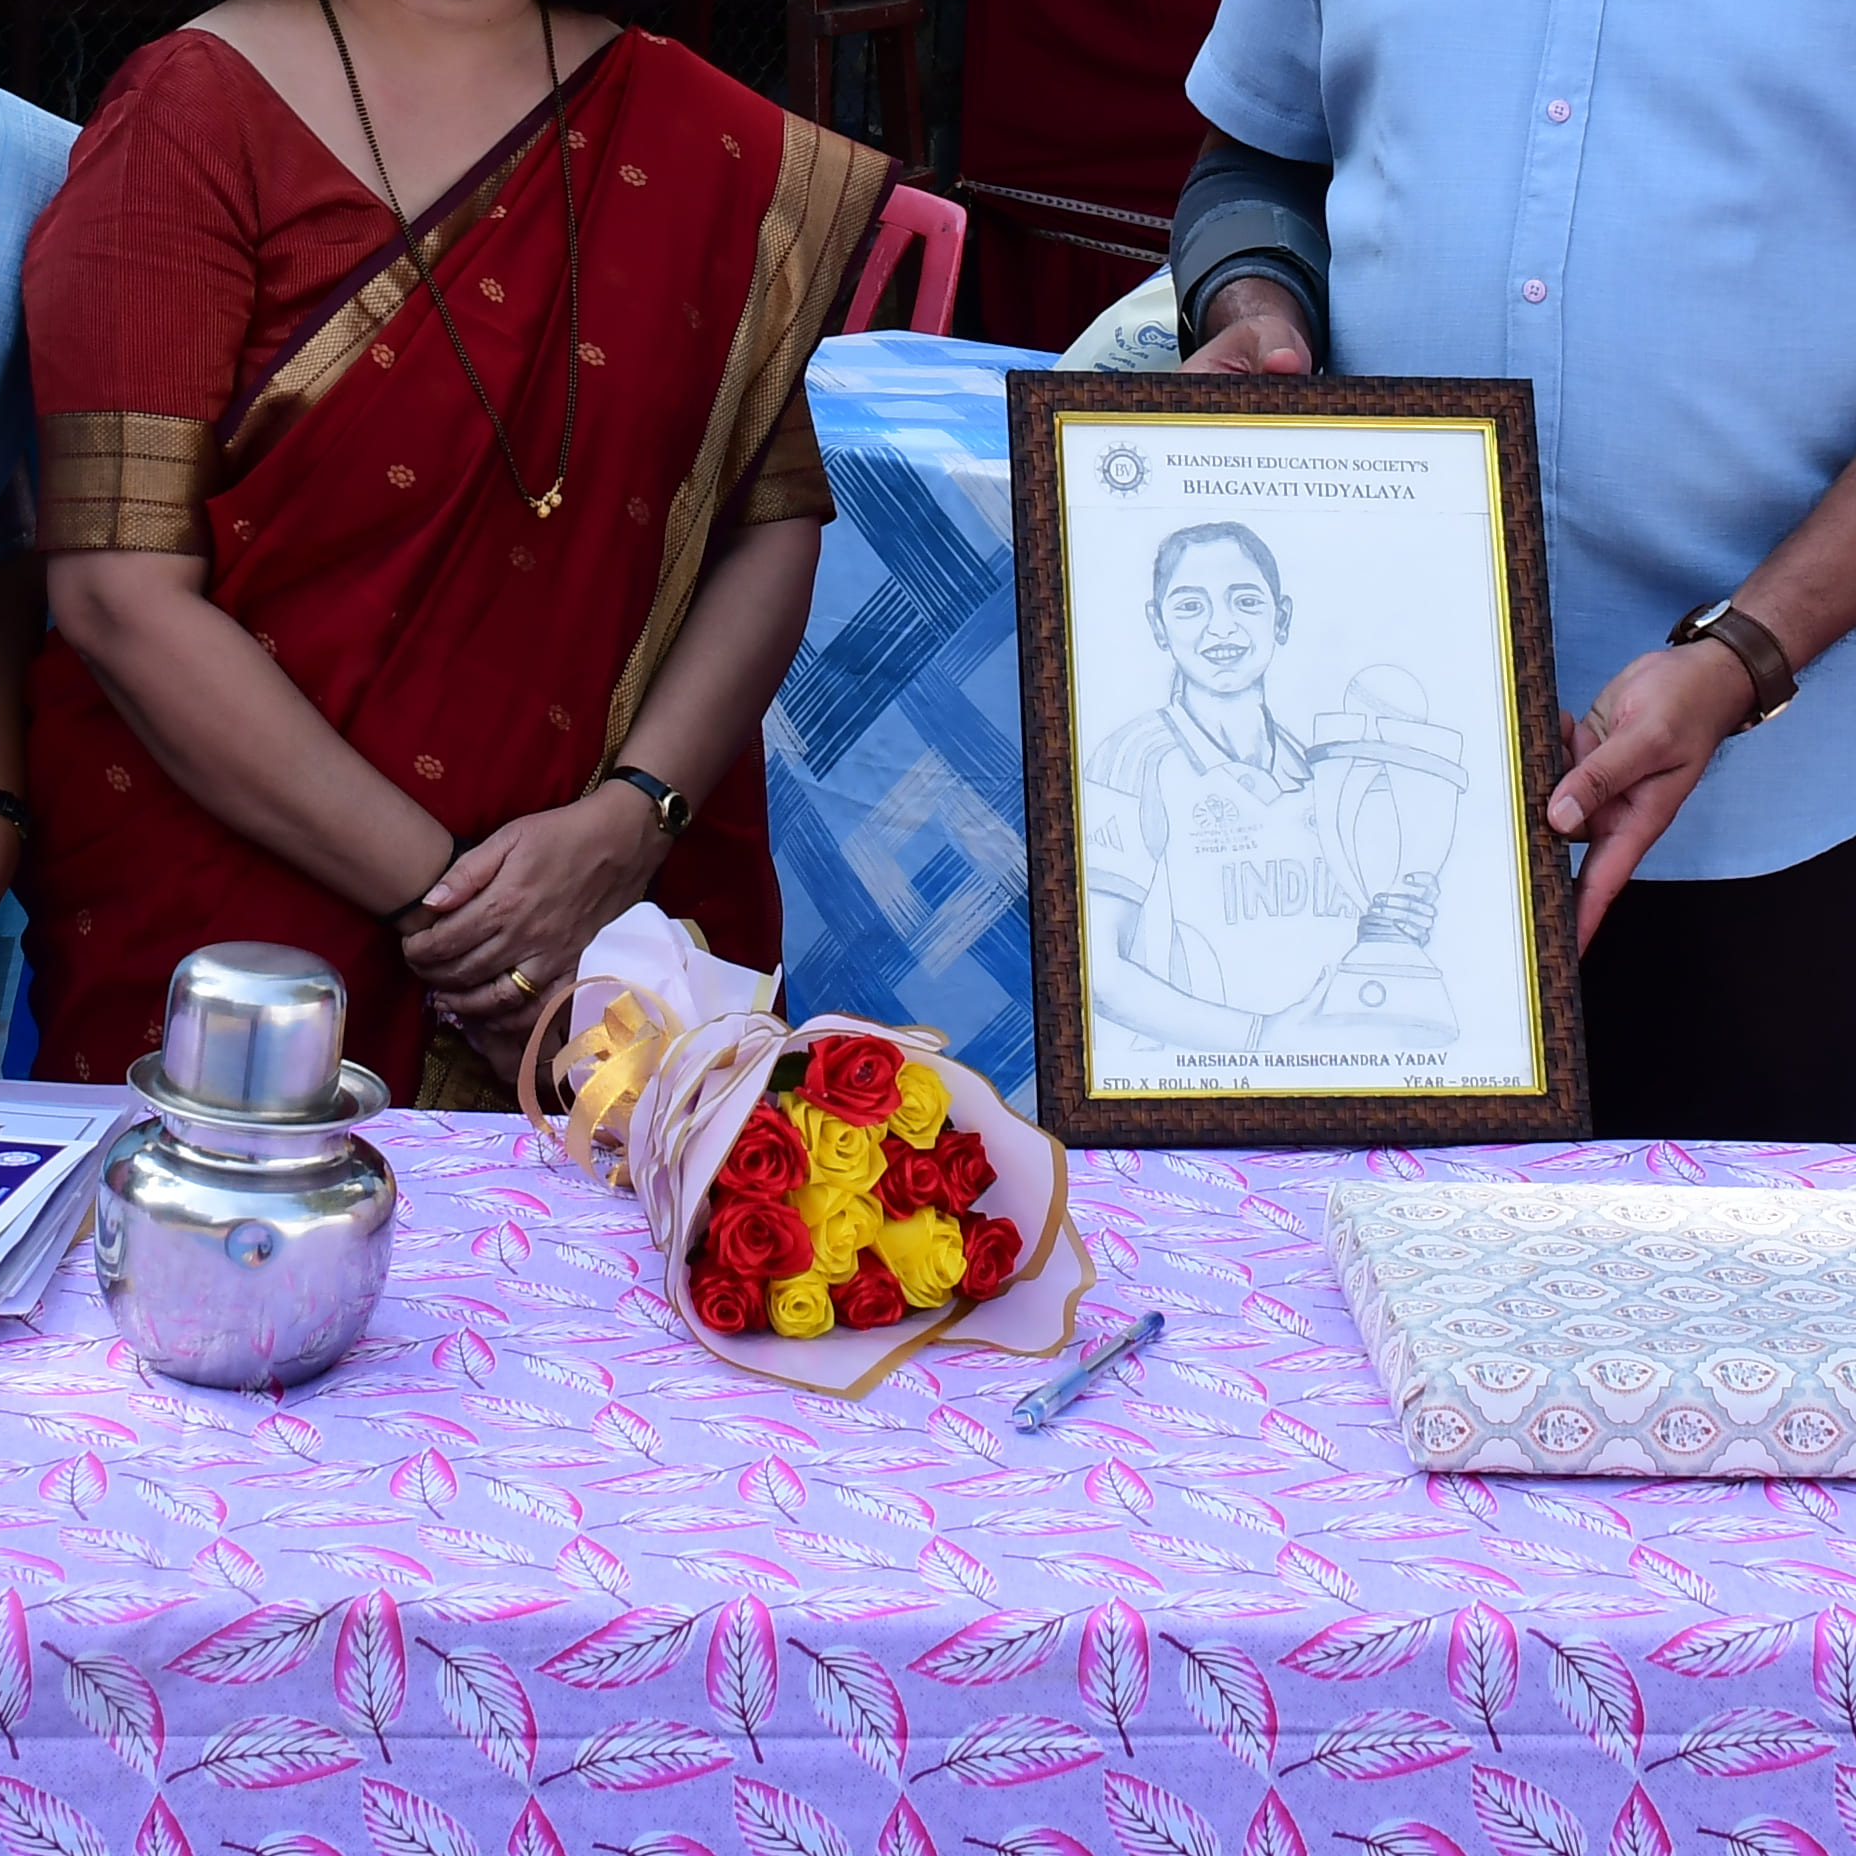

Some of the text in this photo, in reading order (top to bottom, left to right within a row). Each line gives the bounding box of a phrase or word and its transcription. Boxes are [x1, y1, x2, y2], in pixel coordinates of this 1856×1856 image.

[1114, 463, 1134, 477] BV
[1166, 453, 1429, 474] KHANDESH EDUCATION SOCIETY'S
[1182, 479, 1416, 500] BHAGAVATI VIDYALAYA
[1222, 856, 1358, 925] INDIA
[1176, 1051, 1448, 1068] HARSHADA HARISHCHANDRA YADAV
[1102, 1077, 1135, 1091] STD.
[1139, 1077, 1150, 1091] X
[1199, 1077, 1224, 1091] NO.
[1402, 1074, 1444, 1088] YEAR
[1460, 1074, 1522, 1088] 2025-26
